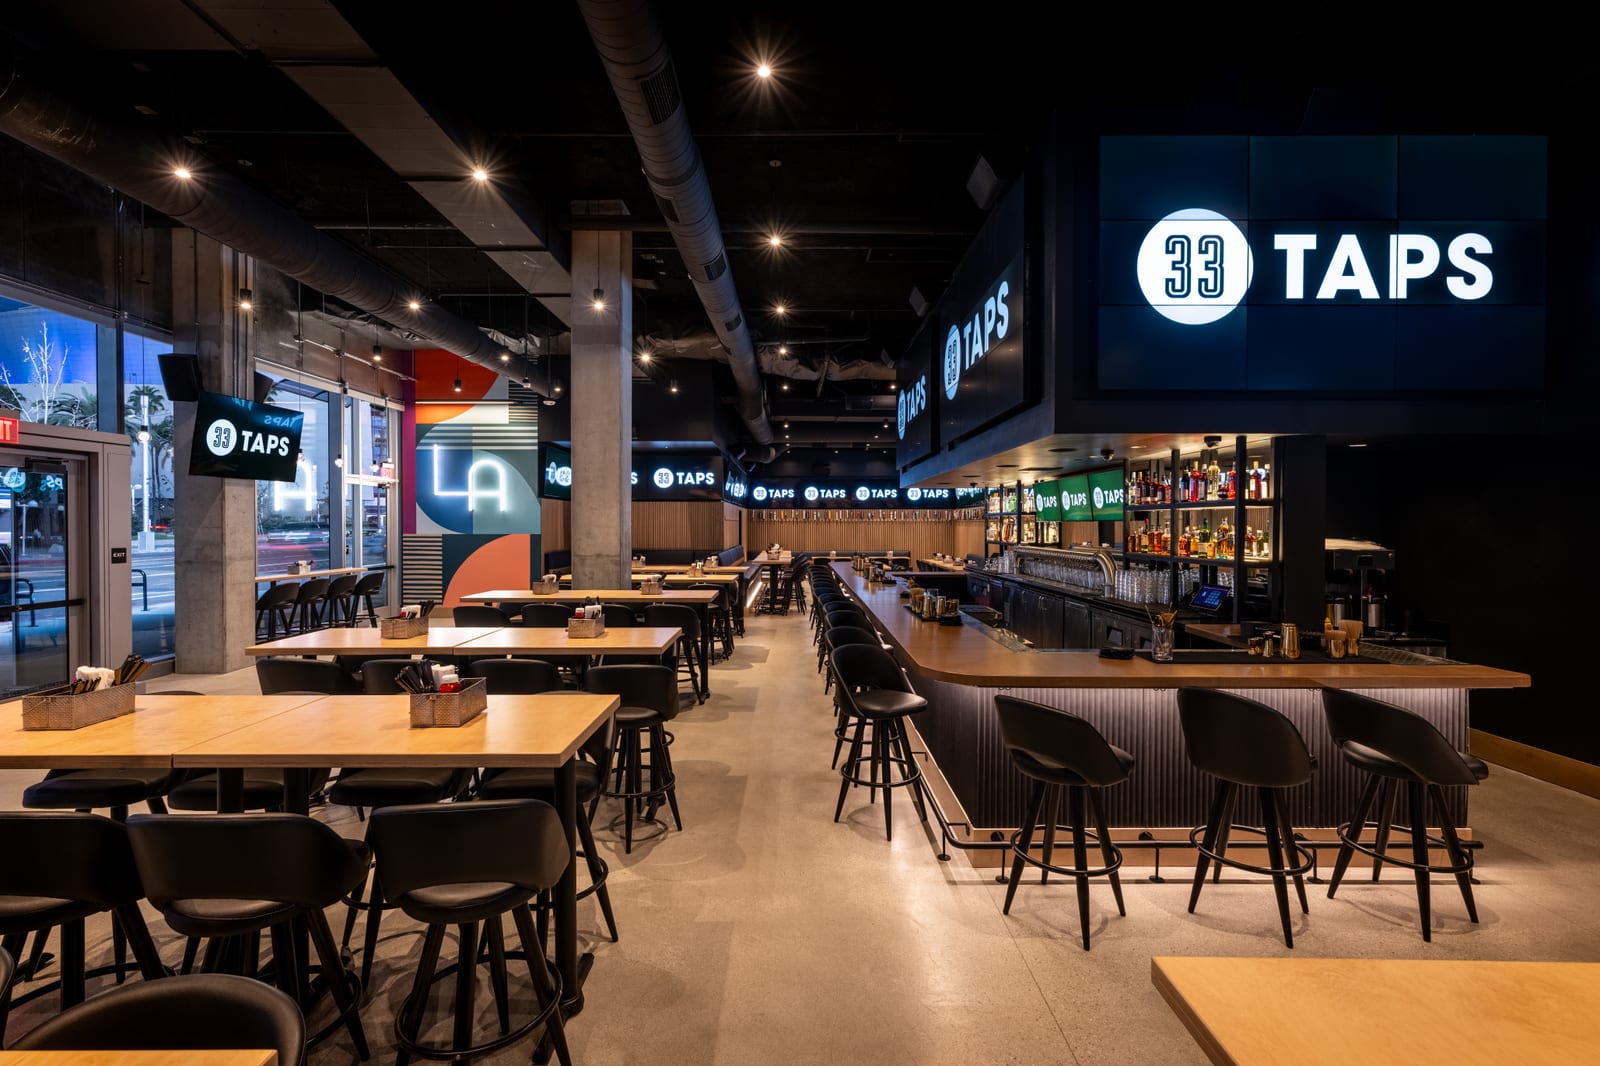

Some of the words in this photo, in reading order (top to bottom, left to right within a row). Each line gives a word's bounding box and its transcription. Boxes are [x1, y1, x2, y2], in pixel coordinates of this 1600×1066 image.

[1165, 234, 1225, 299] 33
[1274, 232, 1494, 300] TAPS
[963, 280, 1009, 371] TAPS
[906, 375, 926, 423] TAPS
[213, 426, 231, 448] 33
[241, 429, 290, 456] TAPS
[432, 443, 506, 512] LA
[676, 471, 715, 485] TAPS
[768, 488, 795, 498] TAPS
[820, 488, 846, 498] TAPS
[871, 488, 897, 498] TAPS
[923, 488, 949, 498] TAPS
[1070, 492, 1087, 506] TAPS
[1104, 488, 1124, 504] TAPS
[1043, 495, 1057, 508] TAPS
